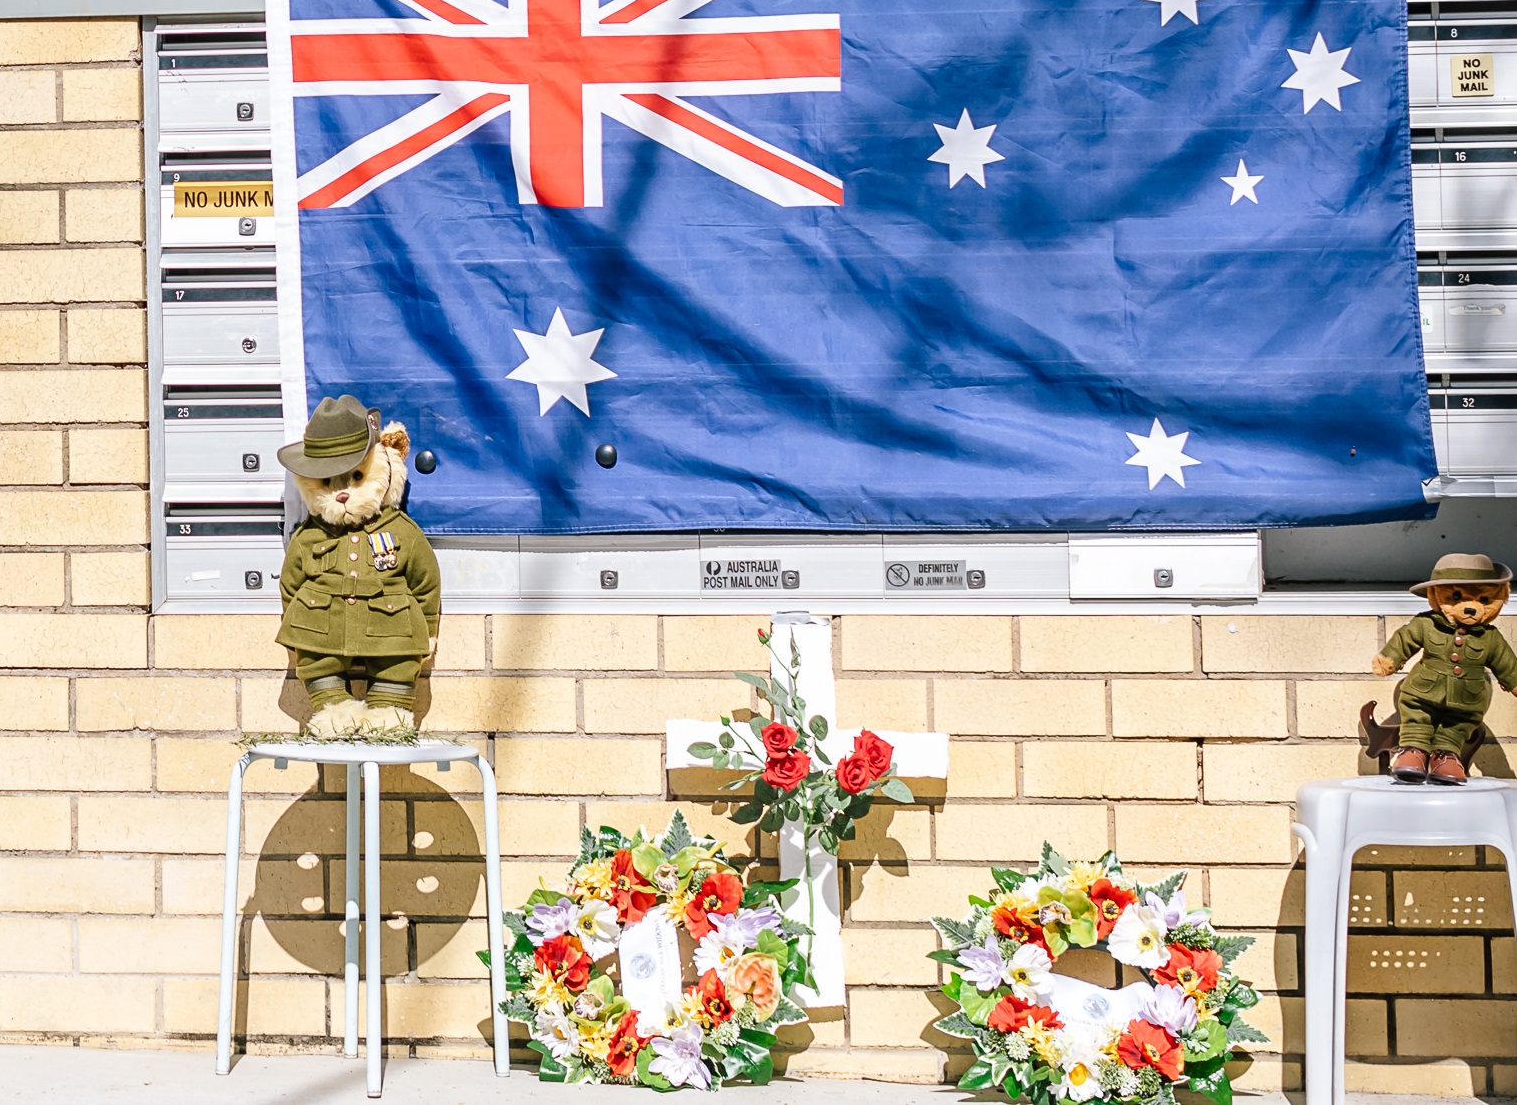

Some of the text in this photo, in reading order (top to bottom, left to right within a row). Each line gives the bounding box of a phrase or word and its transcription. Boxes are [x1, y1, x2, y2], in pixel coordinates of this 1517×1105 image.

[1450, 28, 1458, 38] 8
[171, 58, 177, 69] 1
[1463, 59, 1480, 69] NO
[1457, 70, 1489, 81] JUNK
[1460, 82, 1488, 92] MAIL
[1454, 151, 1467, 162] 16
[173, 173, 180, 183] 9
[184, 191, 208, 208] NO
[214, 190, 258, 207] JUNK
[1458, 273, 1470, 283] 24
[175, 290, 185, 301] 17
[1422, 318, 1431, 326] IL
[1462, 397, 1475, 408] 32
[177, 407, 190, 418] 25
[179, 524, 191, 535] 33
[727, 561, 779, 573] AUSTRALIA
[919, 563, 959, 573] DEFINITELY
[704, 575, 779, 588] POST MAIL ONLY
[914, 577, 924, 586] NO
